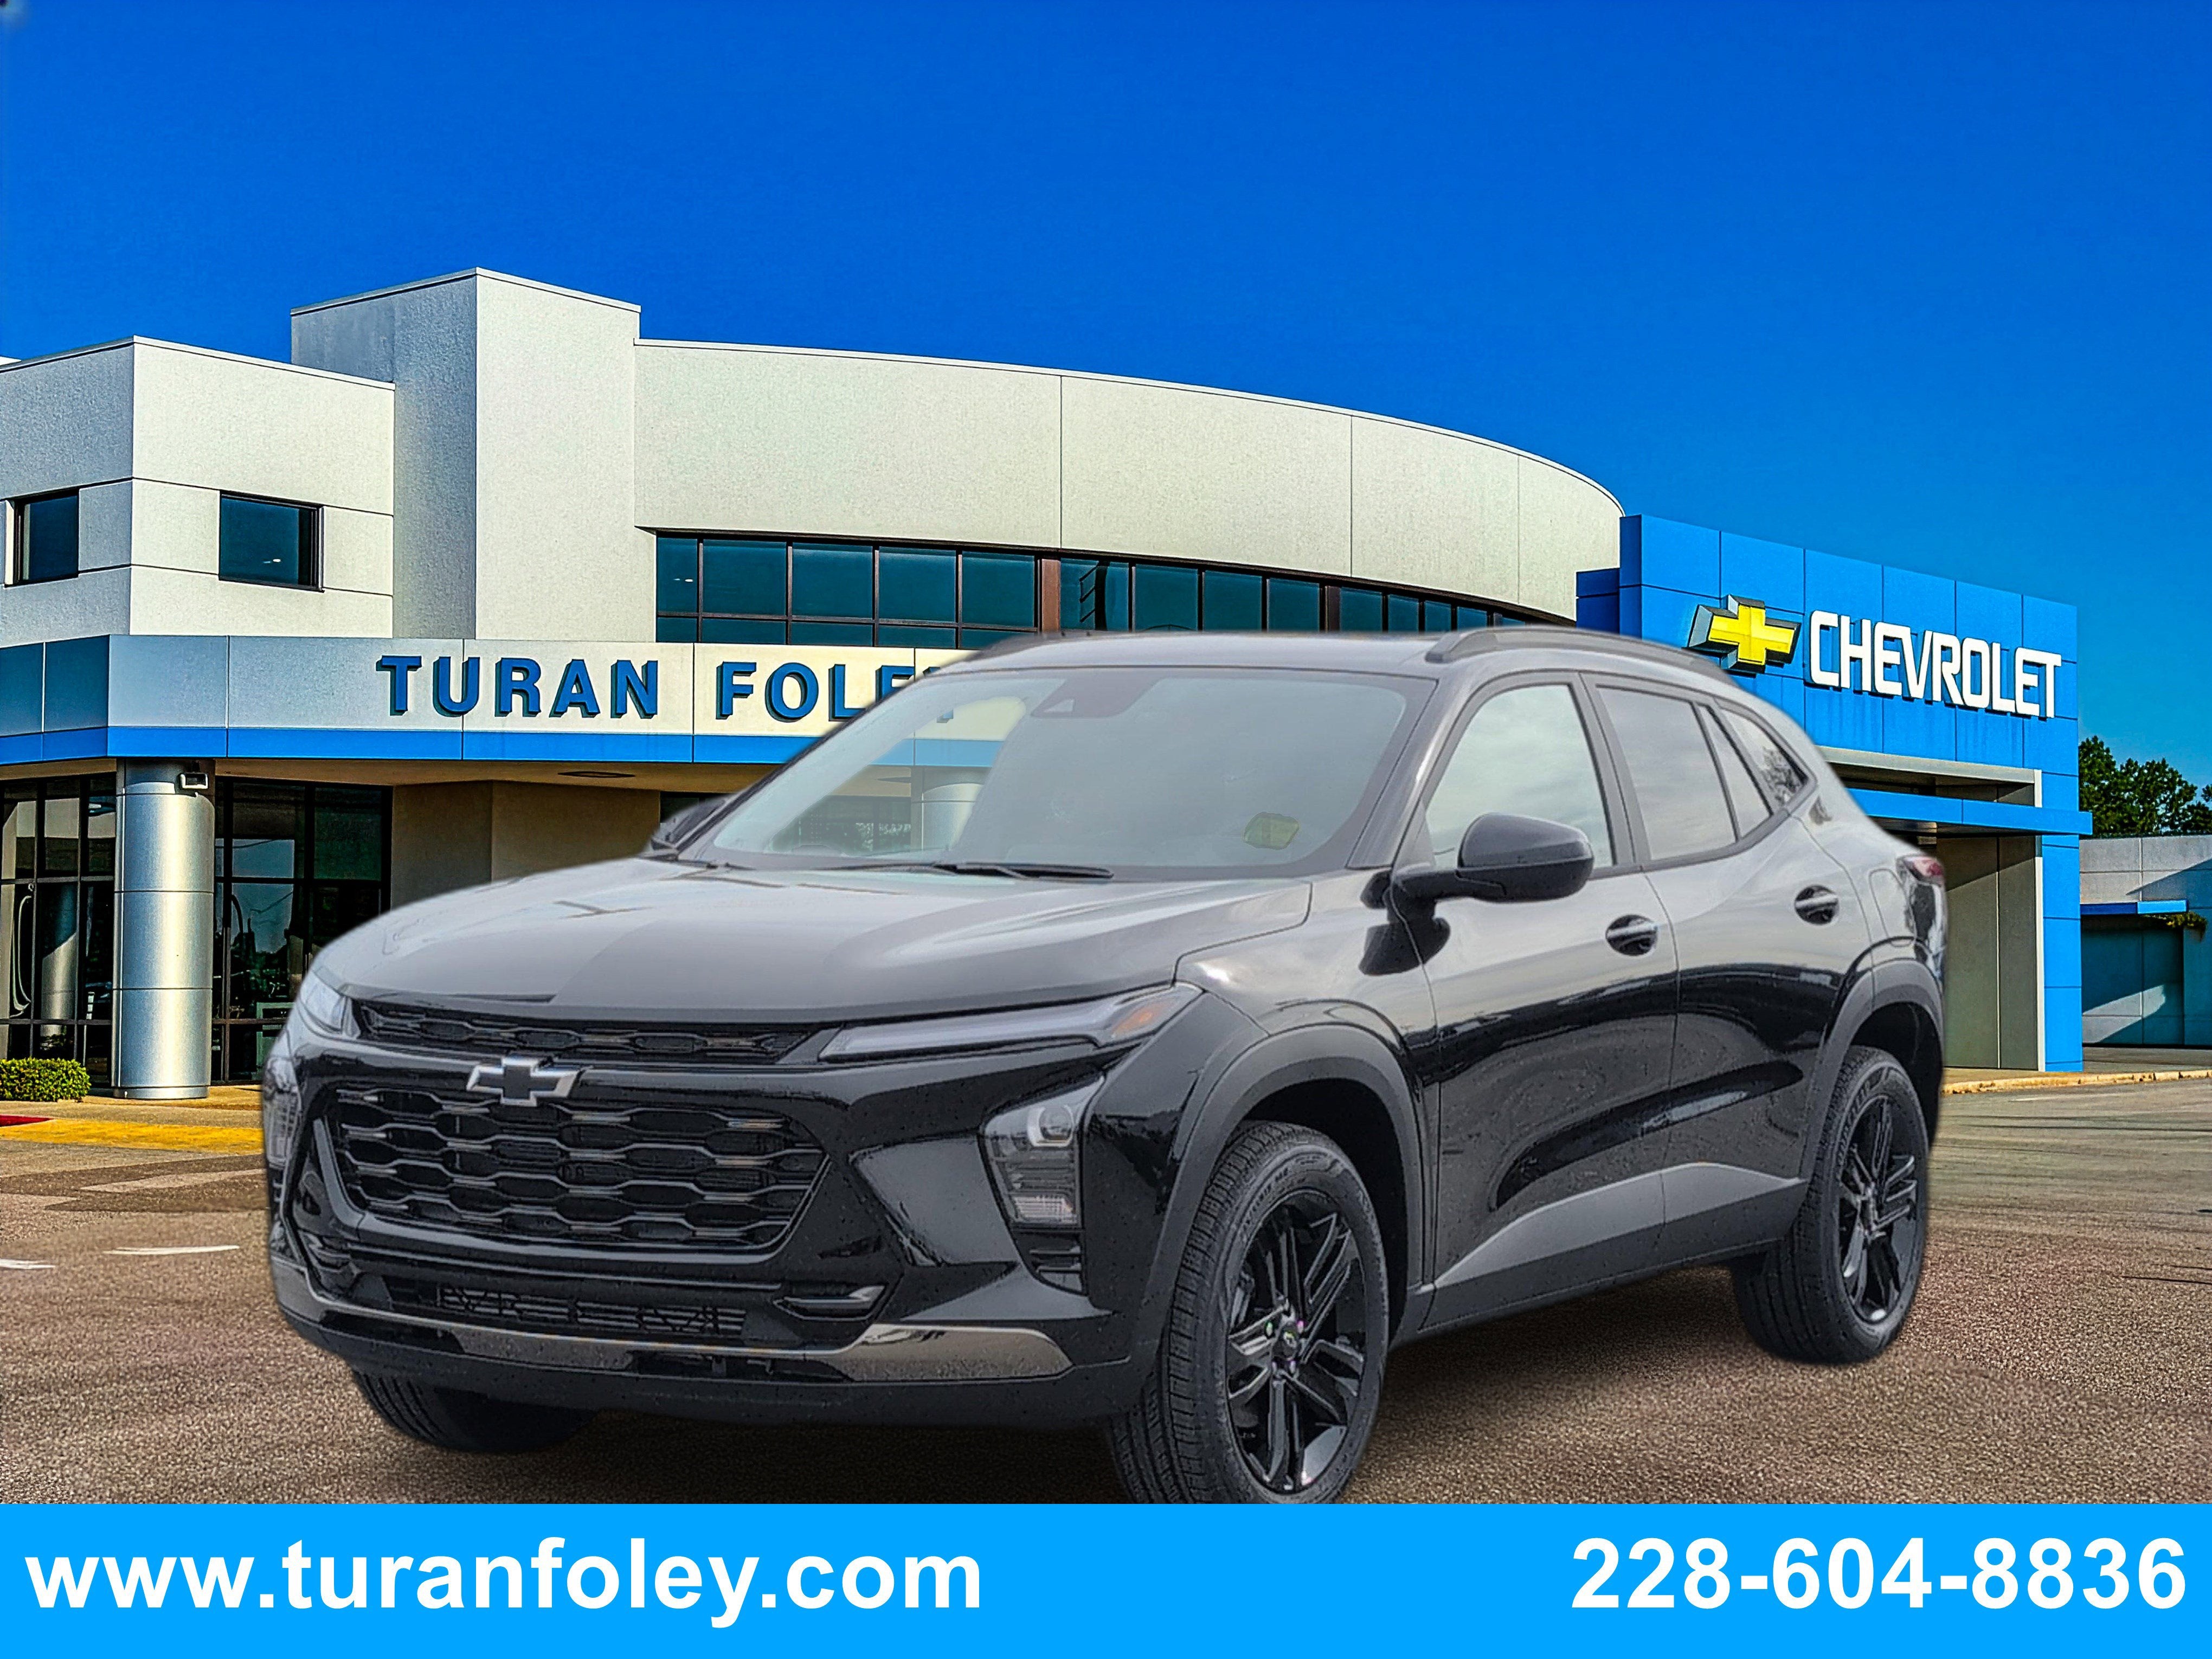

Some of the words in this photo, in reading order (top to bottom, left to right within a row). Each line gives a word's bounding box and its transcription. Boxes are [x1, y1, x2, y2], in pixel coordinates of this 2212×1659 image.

[375, 654, 659, 718] TURAN
[716, 661, 941, 721] FOLE
[1810, 610, 2062, 718] CHEVROLET
